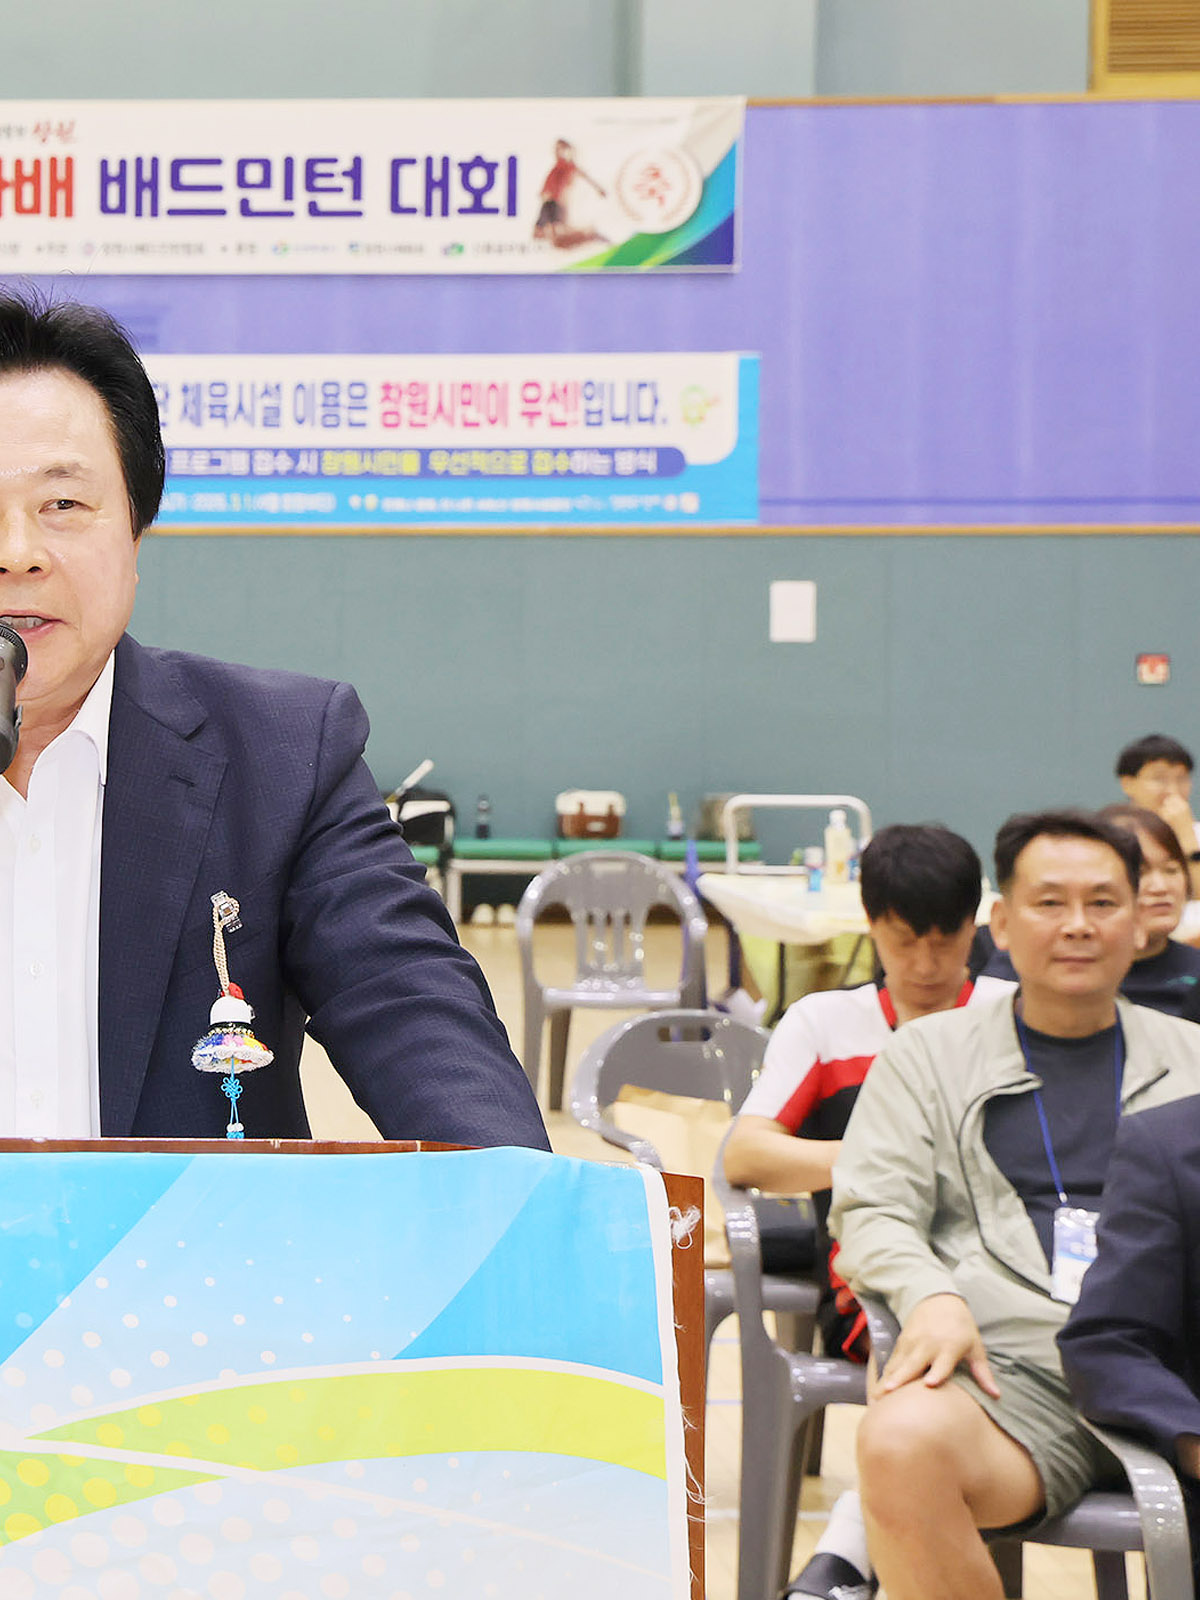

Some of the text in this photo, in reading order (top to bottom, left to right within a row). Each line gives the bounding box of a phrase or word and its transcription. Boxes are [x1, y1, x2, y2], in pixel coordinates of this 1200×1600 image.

[98, 155, 365, 219] 배드민턴
[389, 153, 518, 219] 대회
[180, 381, 283, 429] 체육시설
[293, 380, 370, 429] 이용은
[380, 380, 509, 429] 창원시민이
[169, 450, 250, 476] 프로그램
